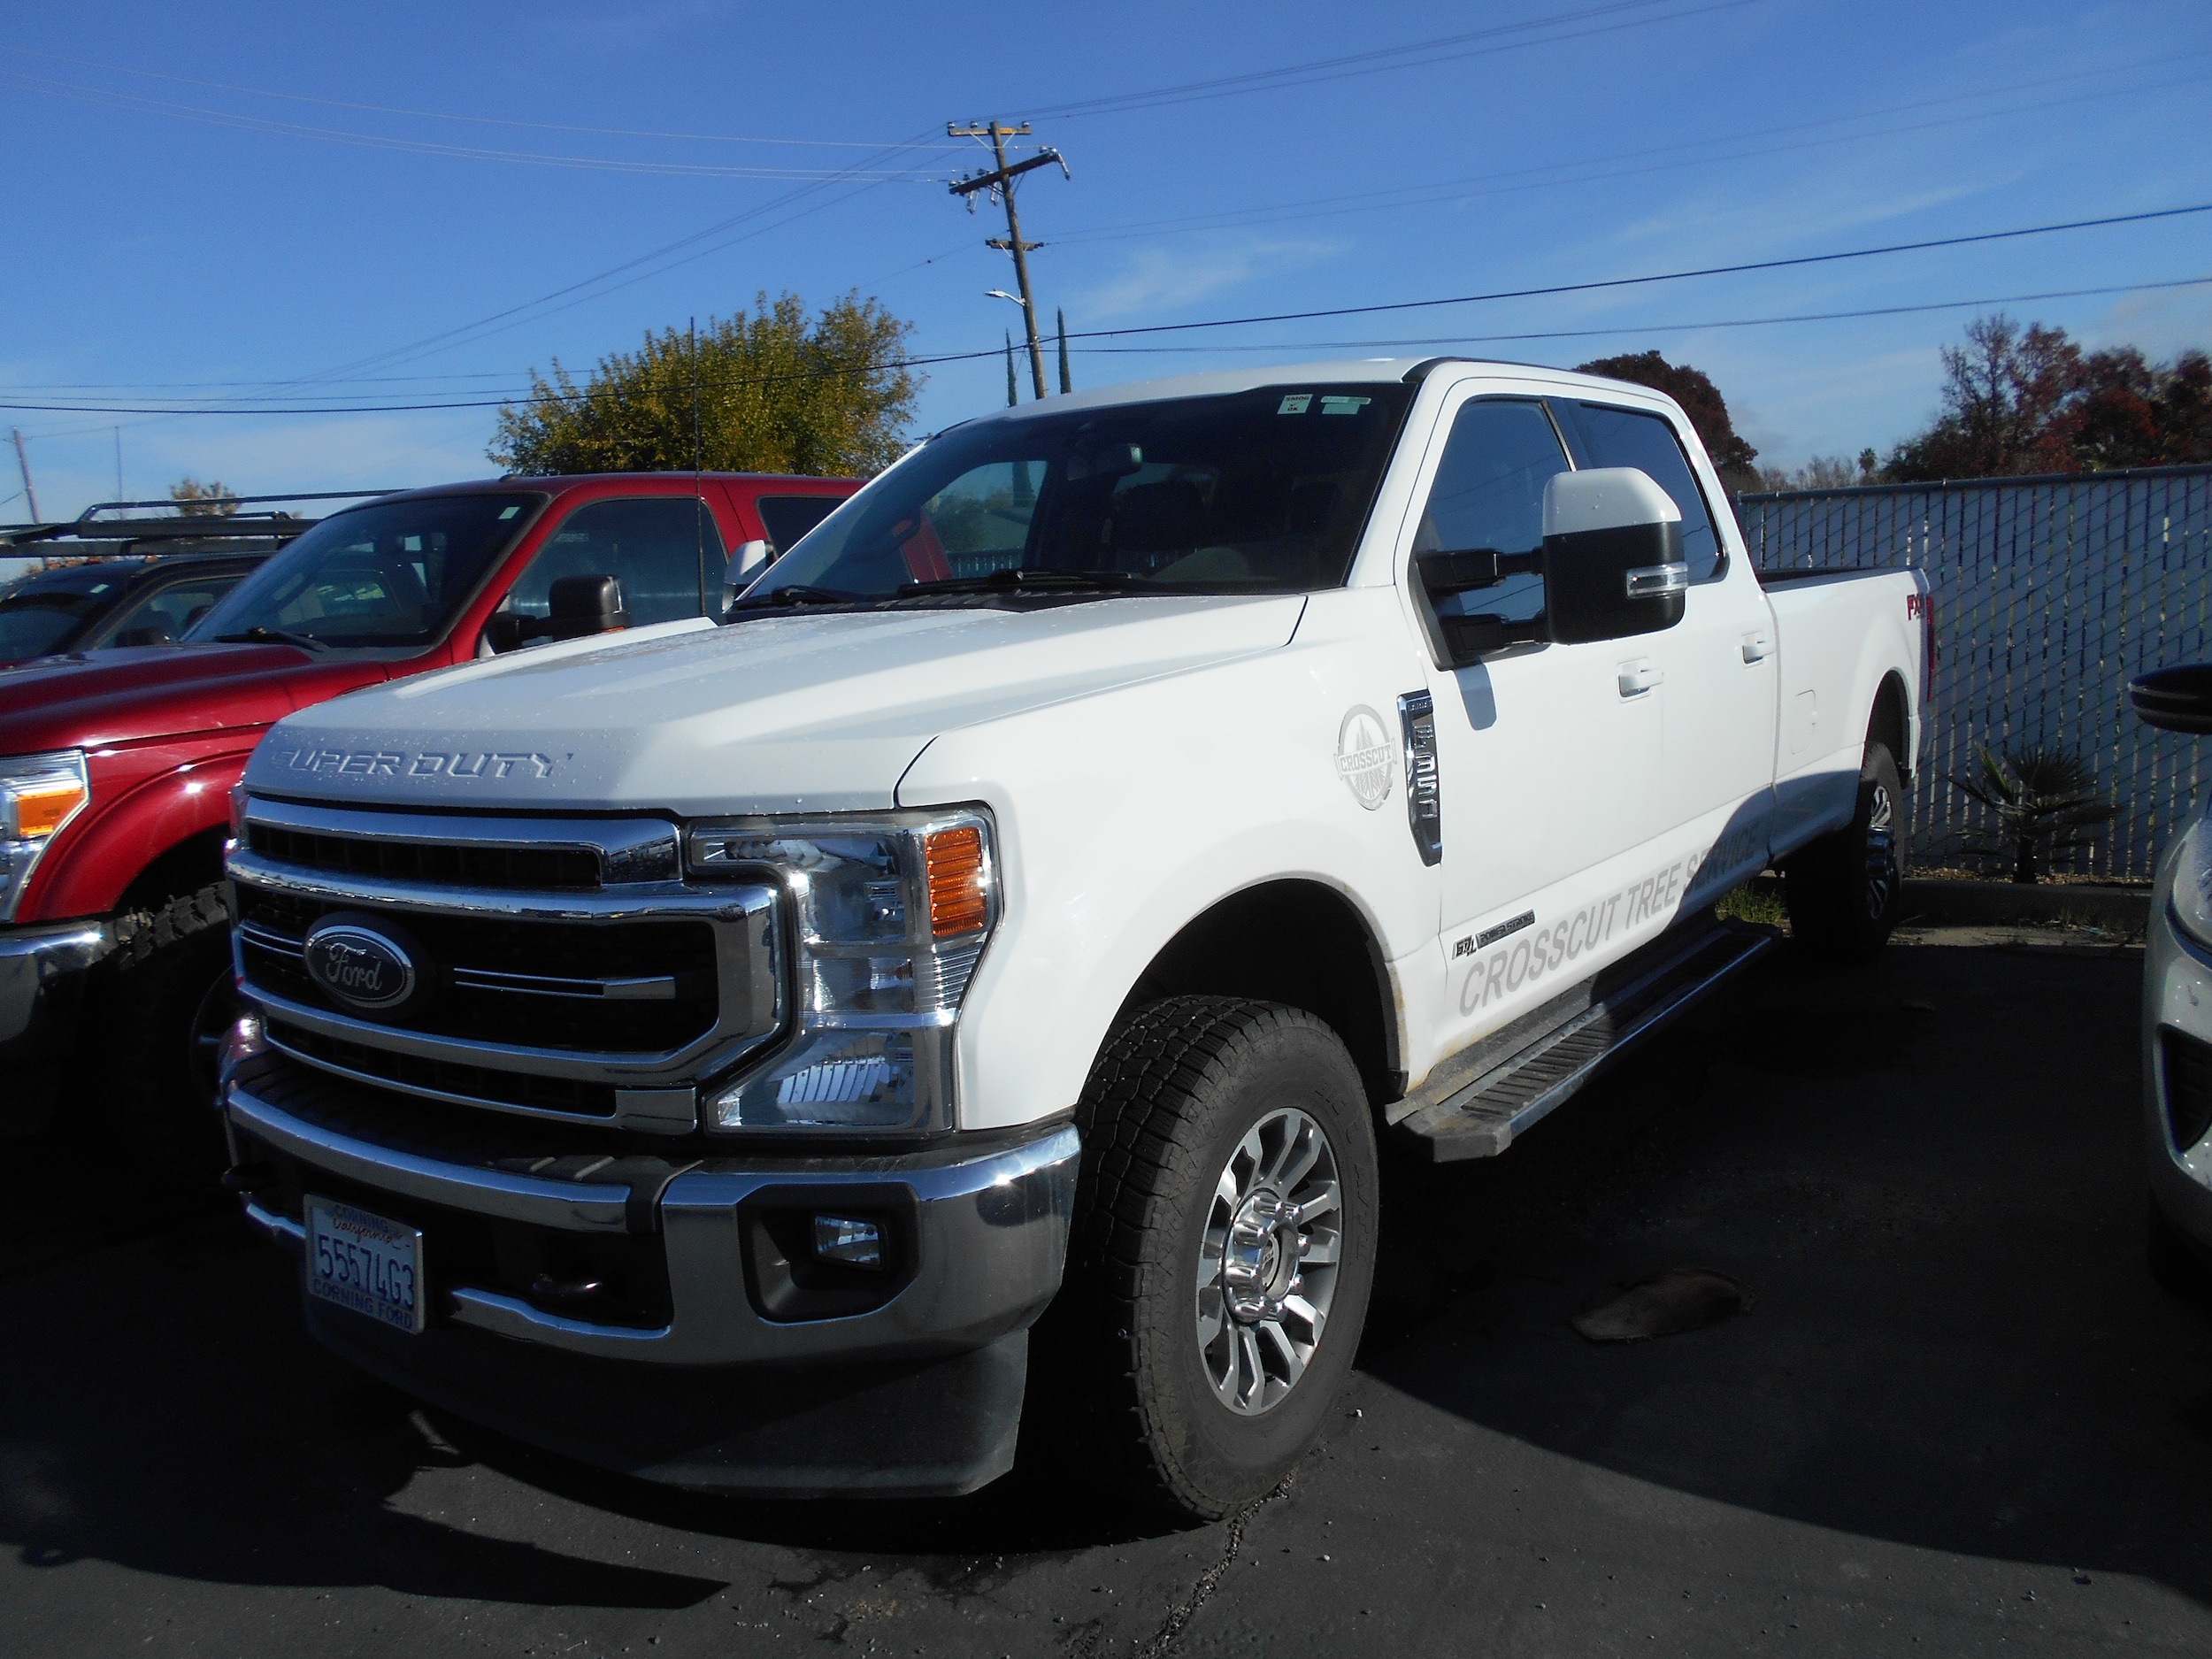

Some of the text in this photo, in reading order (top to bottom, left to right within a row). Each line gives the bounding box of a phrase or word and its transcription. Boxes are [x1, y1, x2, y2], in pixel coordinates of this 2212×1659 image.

[271, 748, 555, 778] SUPER DUTY
[1340, 745, 1393, 772] CROSSCUT
[1458, 891, 1623, 1018] CROSSCUT
[1624, 861, 1683, 930] TREE
[1479, 925, 1507, 944] POWER
[1507, 911, 1535, 931] STROKE
[324, 942, 383, 991] Ford
[333, 1217, 393, 1243] California
[318, 1233, 414, 1310] 55574G3
[312, 1278, 412, 1328] CORNING FORD
